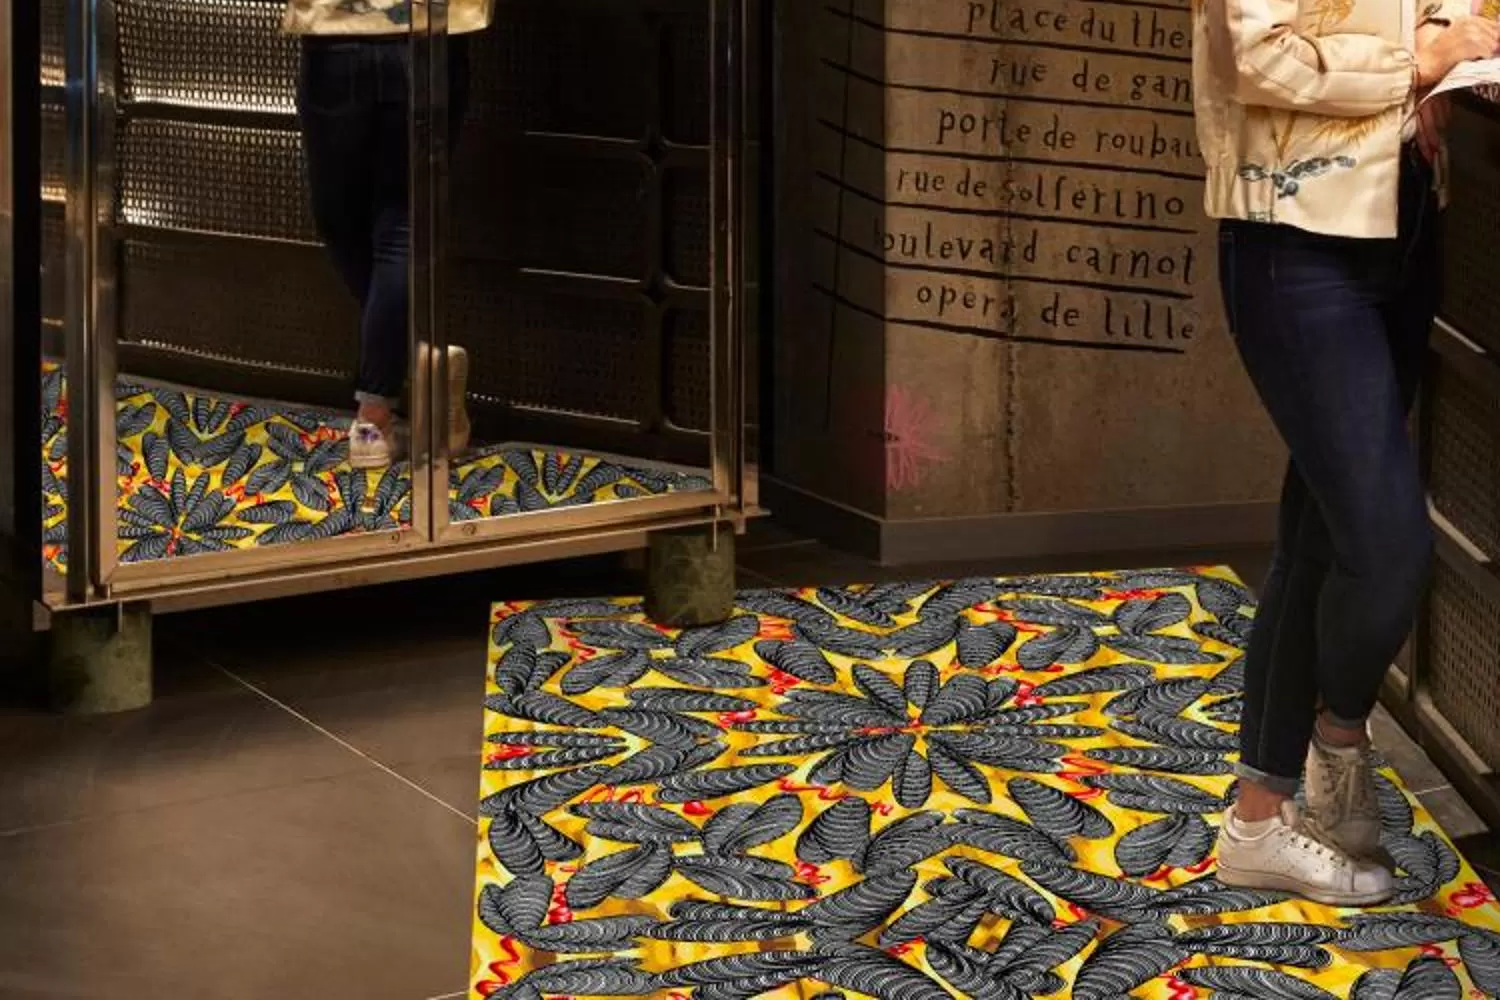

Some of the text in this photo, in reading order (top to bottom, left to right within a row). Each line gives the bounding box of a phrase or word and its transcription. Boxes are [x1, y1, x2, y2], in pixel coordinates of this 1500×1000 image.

[1080, 8, 1116, 42] du
[1132, 10, 1193, 49] the
[989, 58, 1048, 87] rue
[1072, 59, 1110, 92] de
[936, 108, 1203, 158] porte de roubai
[897, 167, 1185, 220] rue de solferino
[1066, 244, 1195, 284] carnot
[916, 284, 1195, 340] opera de lille
